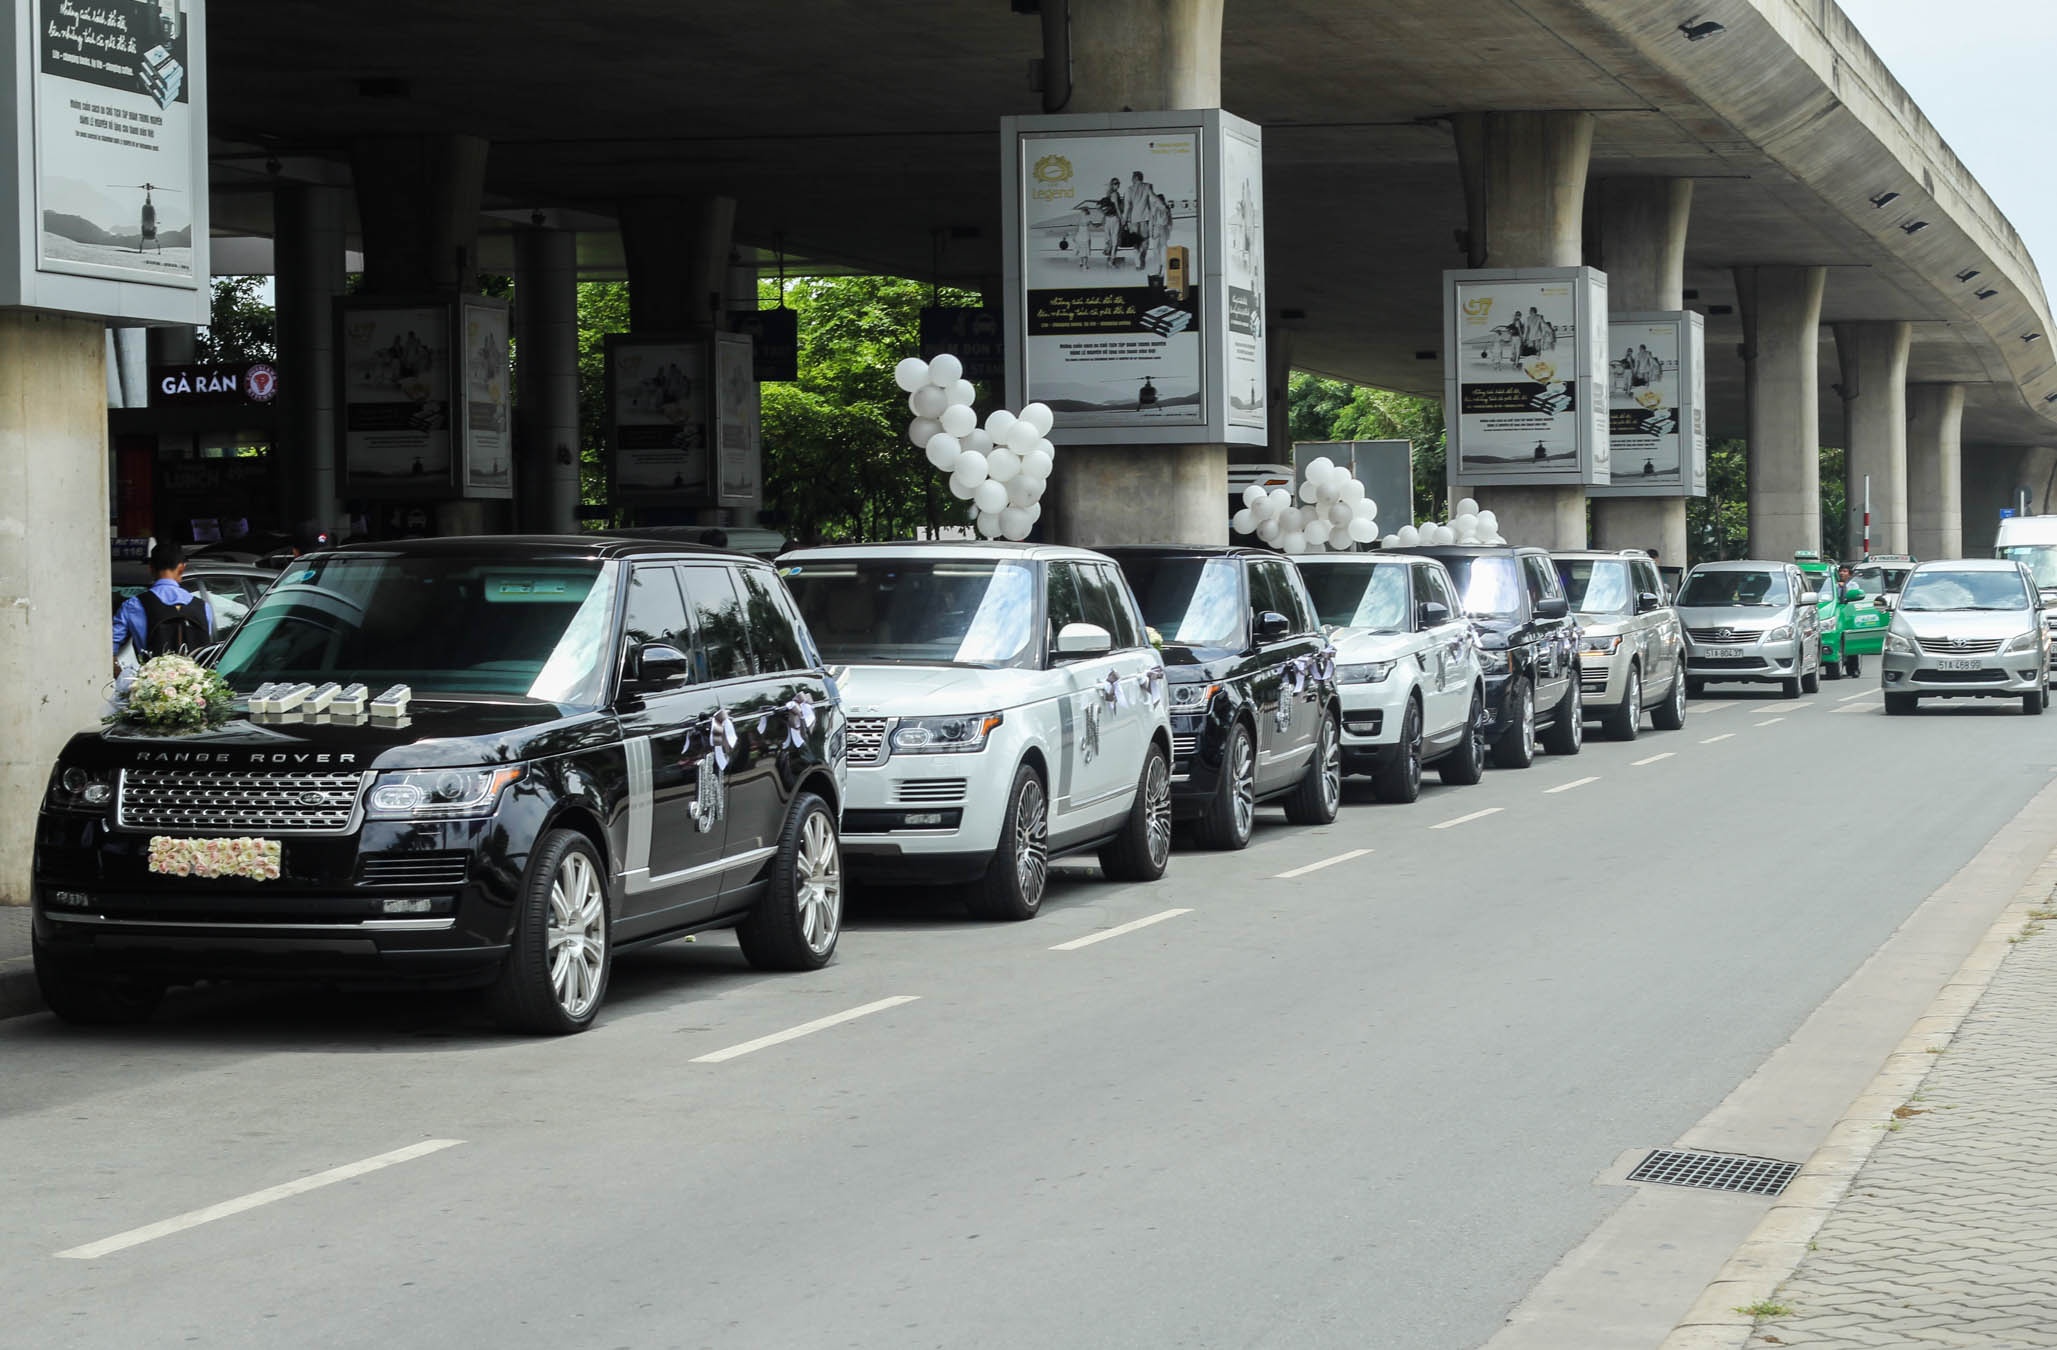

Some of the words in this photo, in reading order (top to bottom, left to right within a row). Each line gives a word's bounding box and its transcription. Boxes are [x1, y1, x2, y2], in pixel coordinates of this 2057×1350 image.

[1032, 186, 1074, 201] Legend
[161, 371, 191, 395] GÀ
[195, 370, 237, 393] RÁN
[136, 751, 230, 763] RANGE
[250, 753, 355, 763] ROVER
